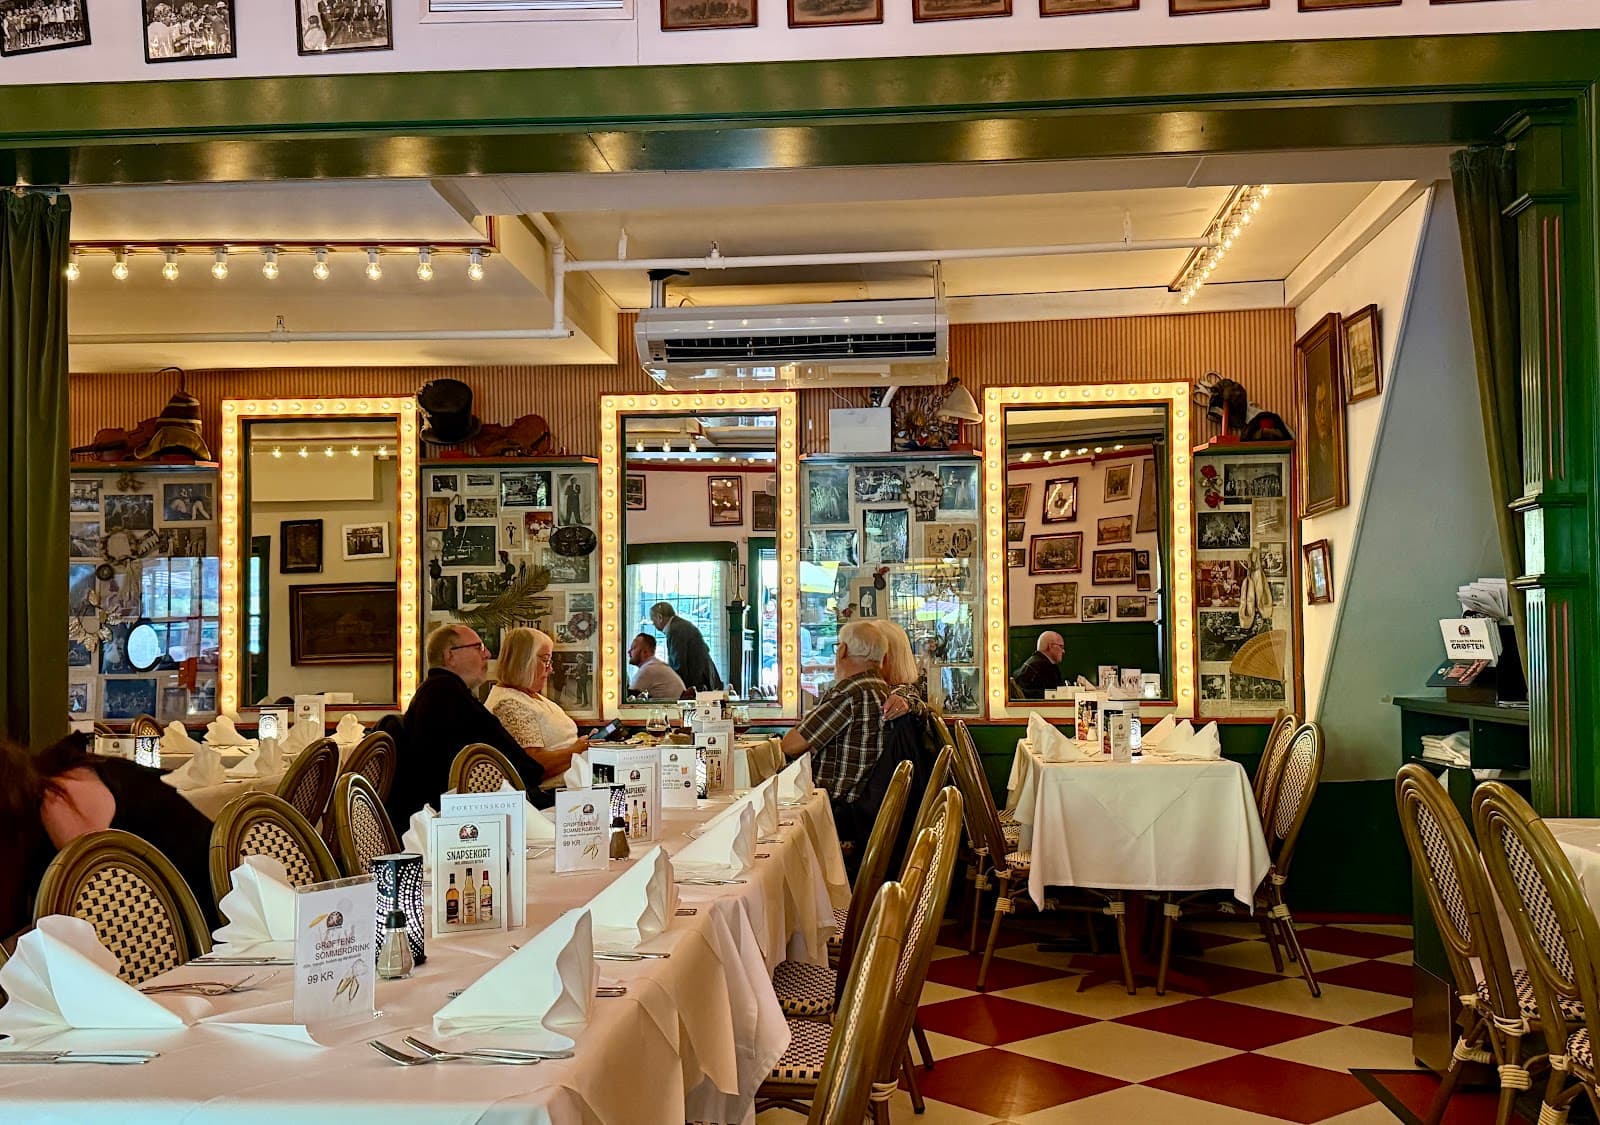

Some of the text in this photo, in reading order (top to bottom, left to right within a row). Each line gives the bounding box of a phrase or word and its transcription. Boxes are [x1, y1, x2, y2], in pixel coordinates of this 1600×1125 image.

[446, 848, 491, 861] SNAPSEKORT
[315, 935, 356, 951] GRØFTENS
[315, 942, 370, 961] SOMMERDRINK
[307, 970, 334, 985] 99 KR
